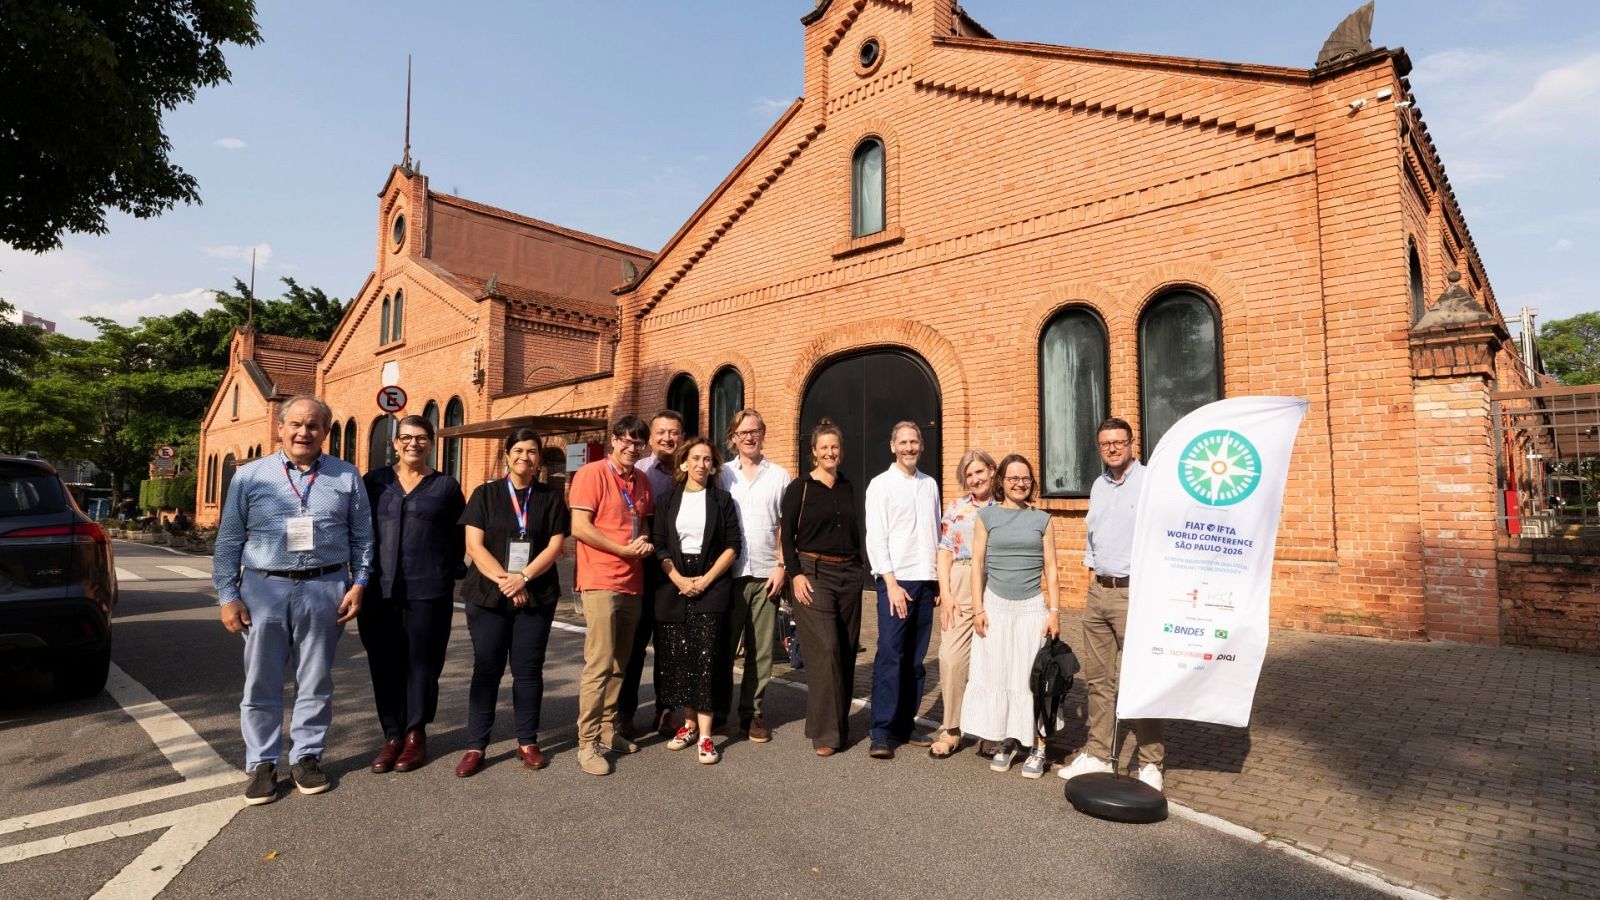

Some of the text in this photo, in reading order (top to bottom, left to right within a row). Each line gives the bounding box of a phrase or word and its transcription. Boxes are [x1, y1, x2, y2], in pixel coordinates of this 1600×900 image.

[1185, 521, 1236, 535] FIAT IFTA
[1167, 530, 1253, 548] WORLD CONFERENCE
[1175, 541, 1243, 555] SÃO PAULO 2026
[1174, 625, 1205, 637] BNDES
